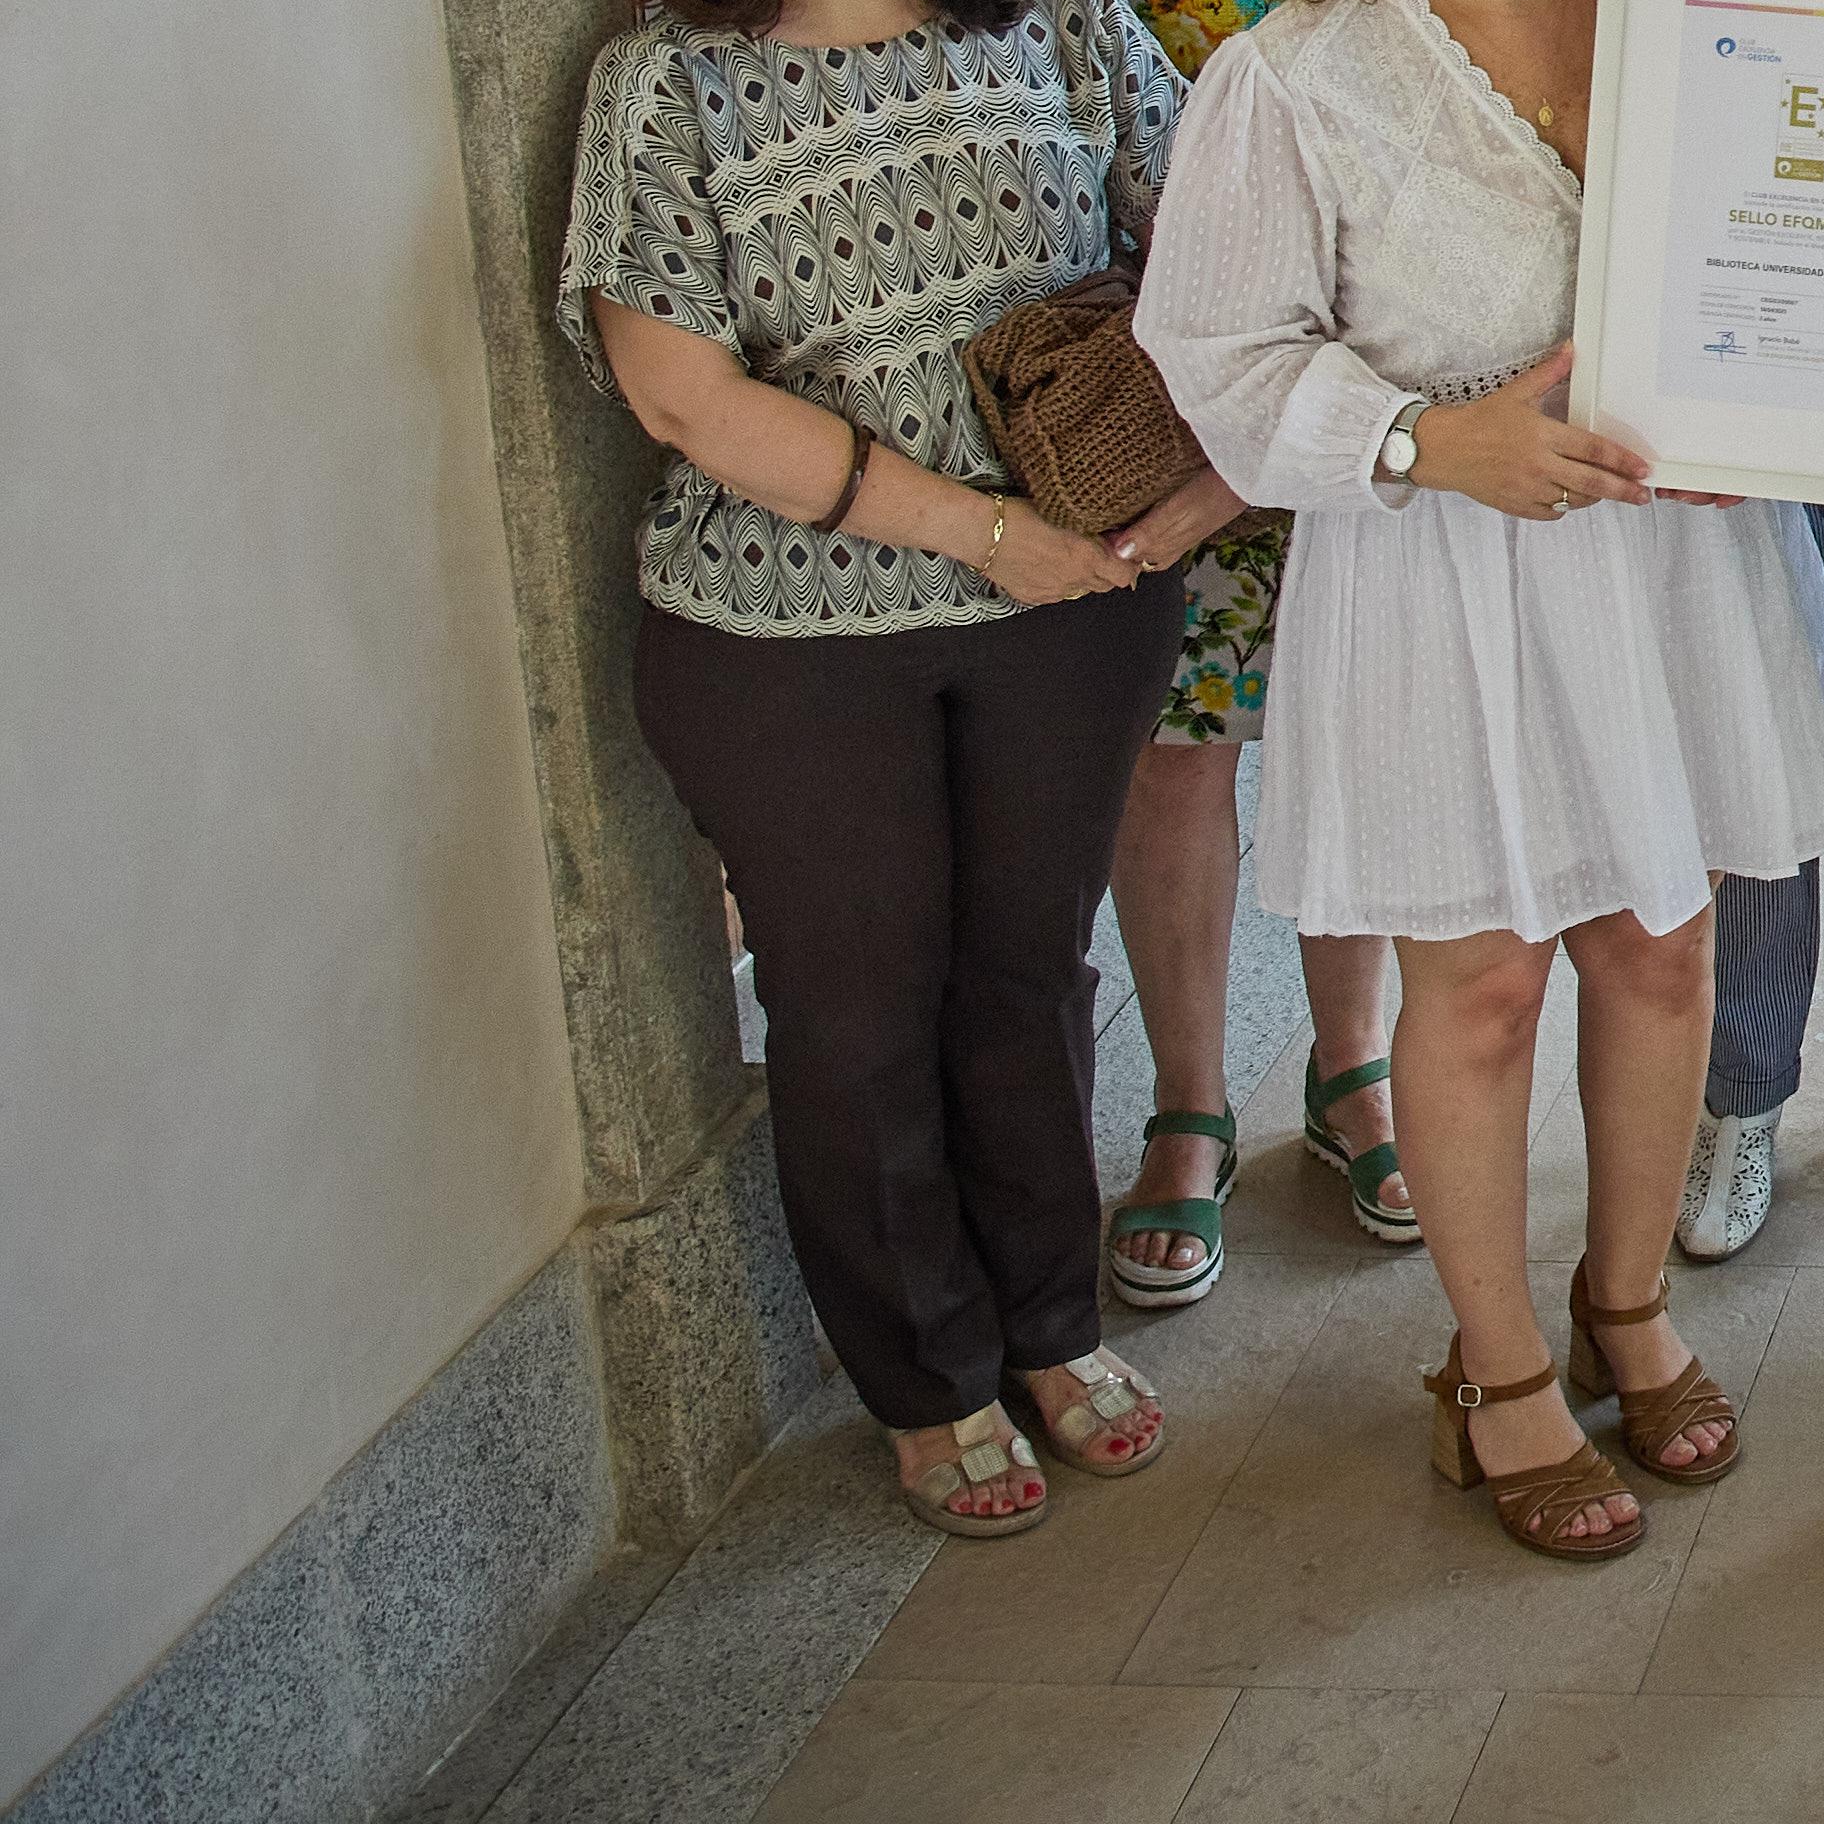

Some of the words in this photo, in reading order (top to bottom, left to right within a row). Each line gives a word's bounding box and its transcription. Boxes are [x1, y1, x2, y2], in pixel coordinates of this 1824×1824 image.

[1728, 209, 1778, 226] SELLO
[1706, 258, 1760, 272] BIBLIOTECA
[1762, 263, 1824, 278] UNIVERSIDAD
